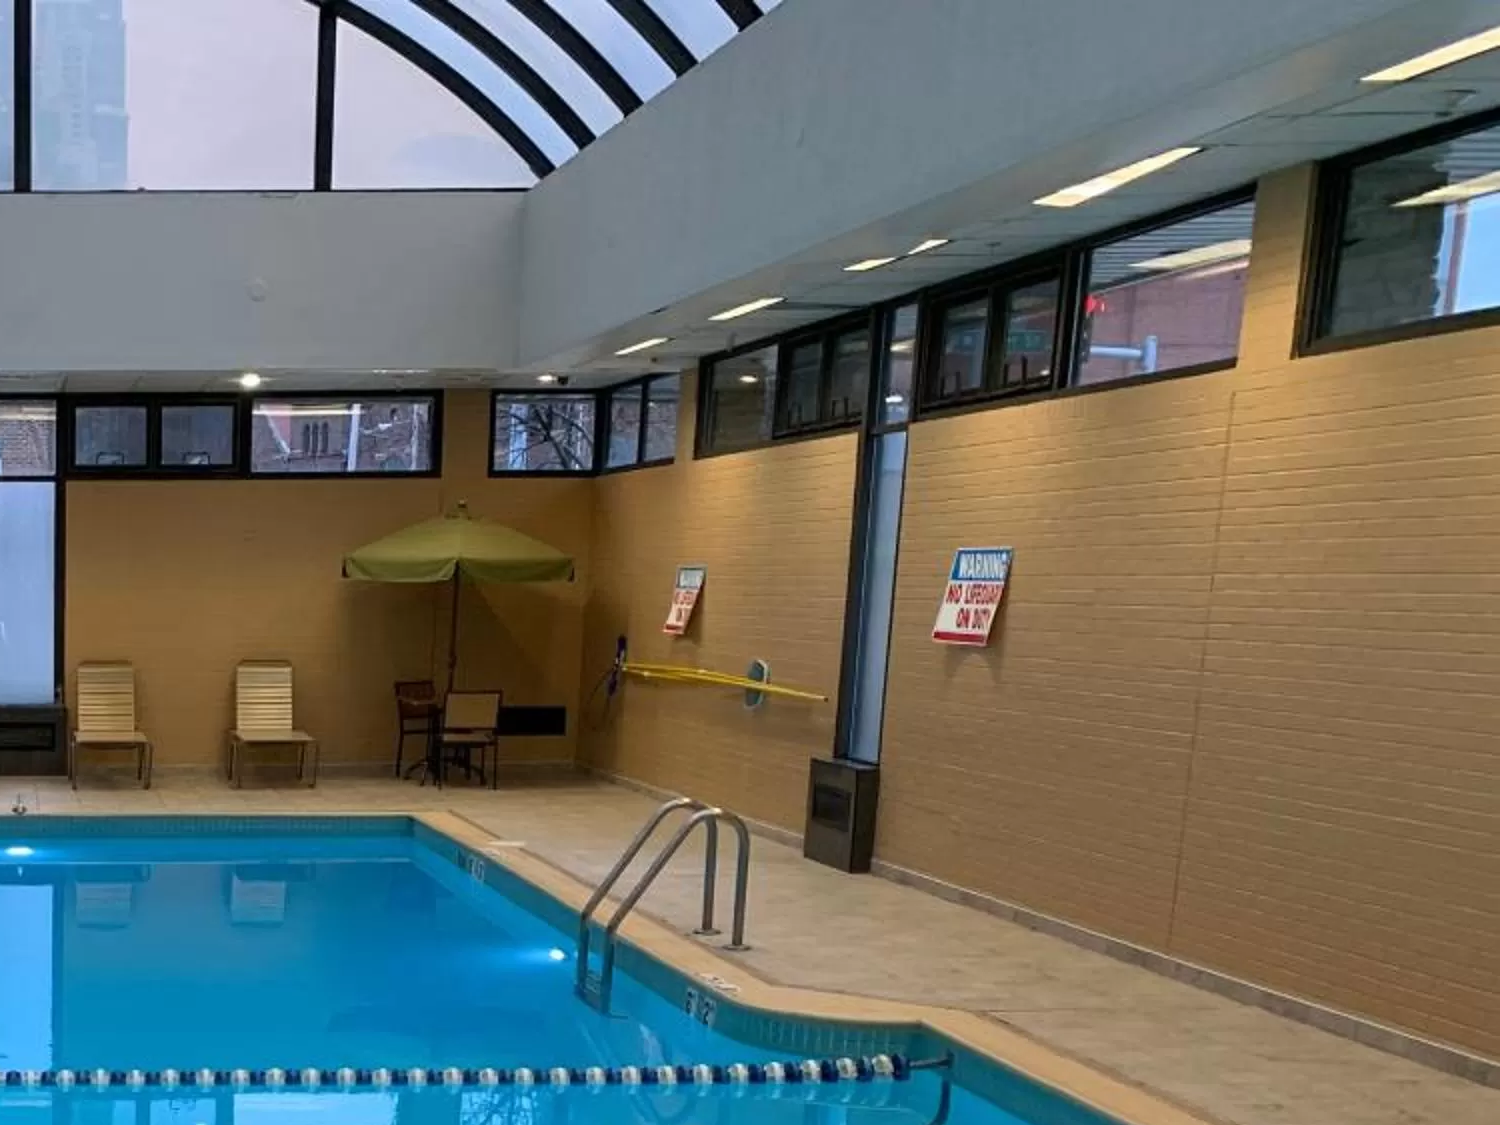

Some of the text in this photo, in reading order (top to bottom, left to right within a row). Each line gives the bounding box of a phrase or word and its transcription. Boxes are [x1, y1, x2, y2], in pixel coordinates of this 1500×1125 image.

[958, 552, 1009, 579] WARNING
[946, 583, 962, 604] NO
[956, 607, 970, 628] ON
